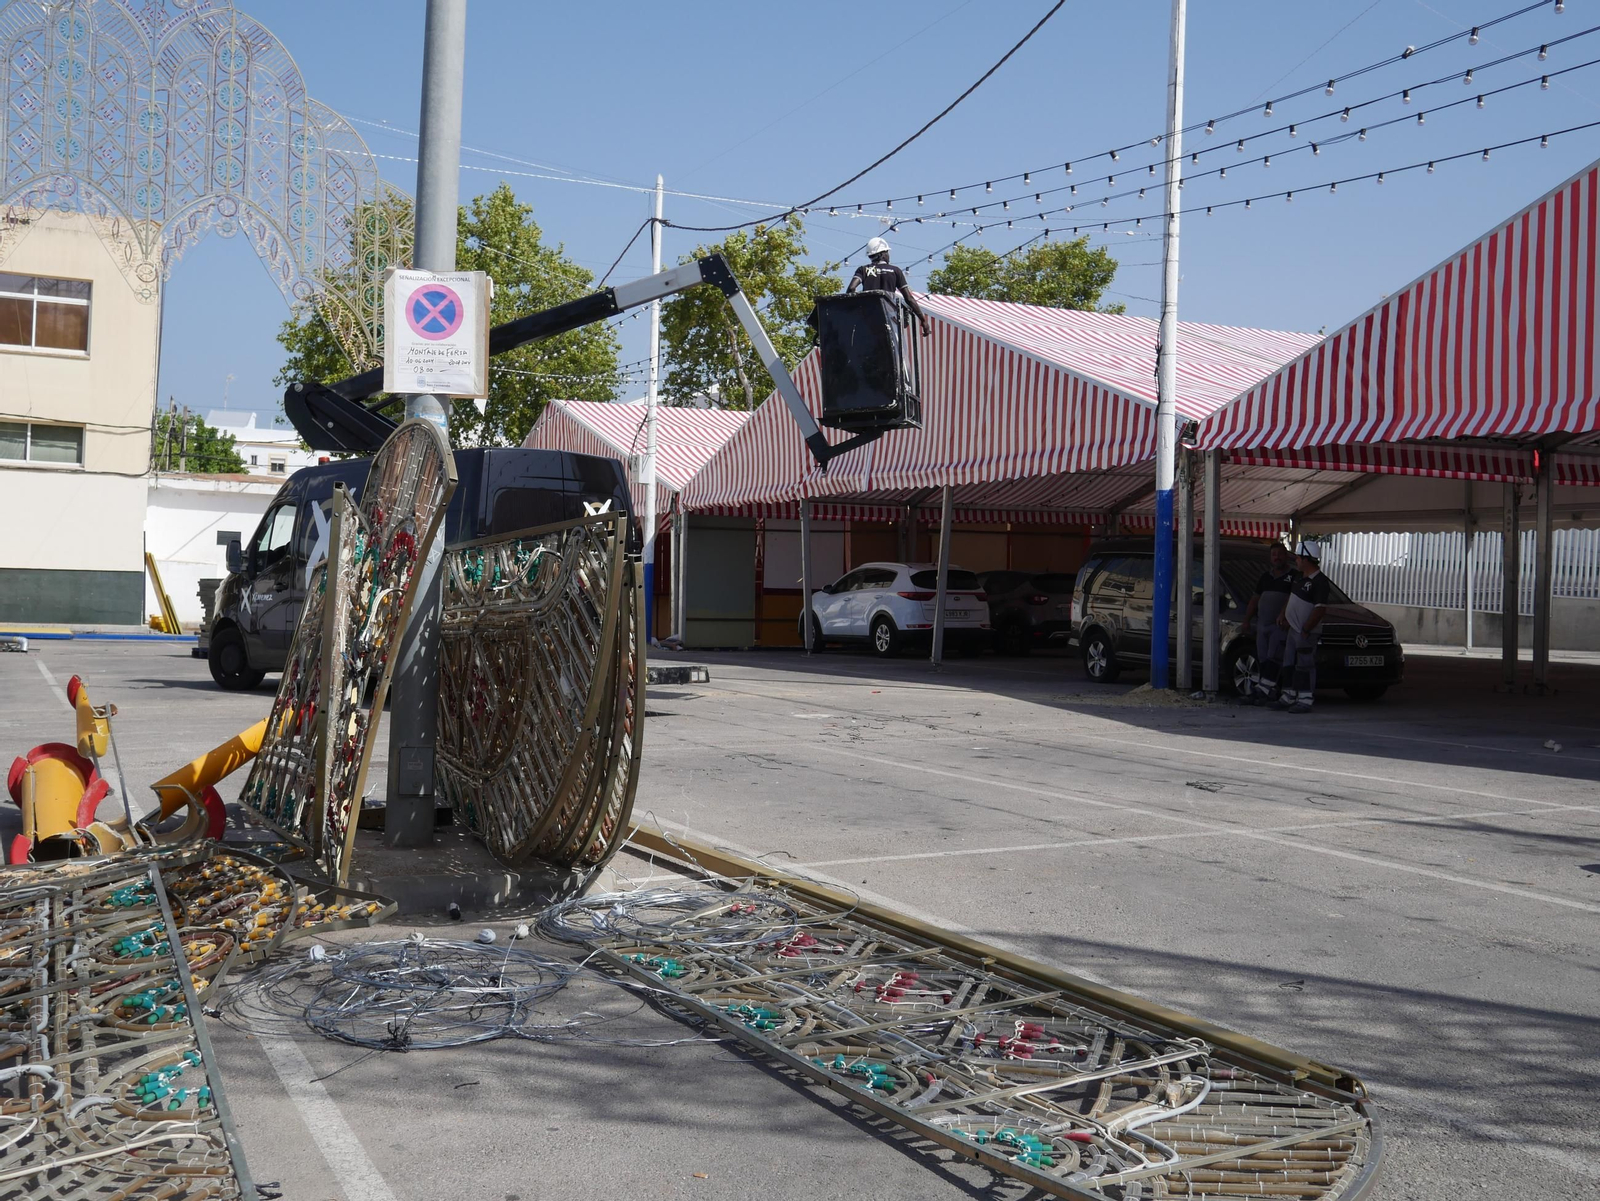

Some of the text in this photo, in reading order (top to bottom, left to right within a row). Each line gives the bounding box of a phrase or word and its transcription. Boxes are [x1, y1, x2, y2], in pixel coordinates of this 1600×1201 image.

[407, 347, 437, 356] MONTAJE
[1349, 656, 1383, 665] 2755 KZB
